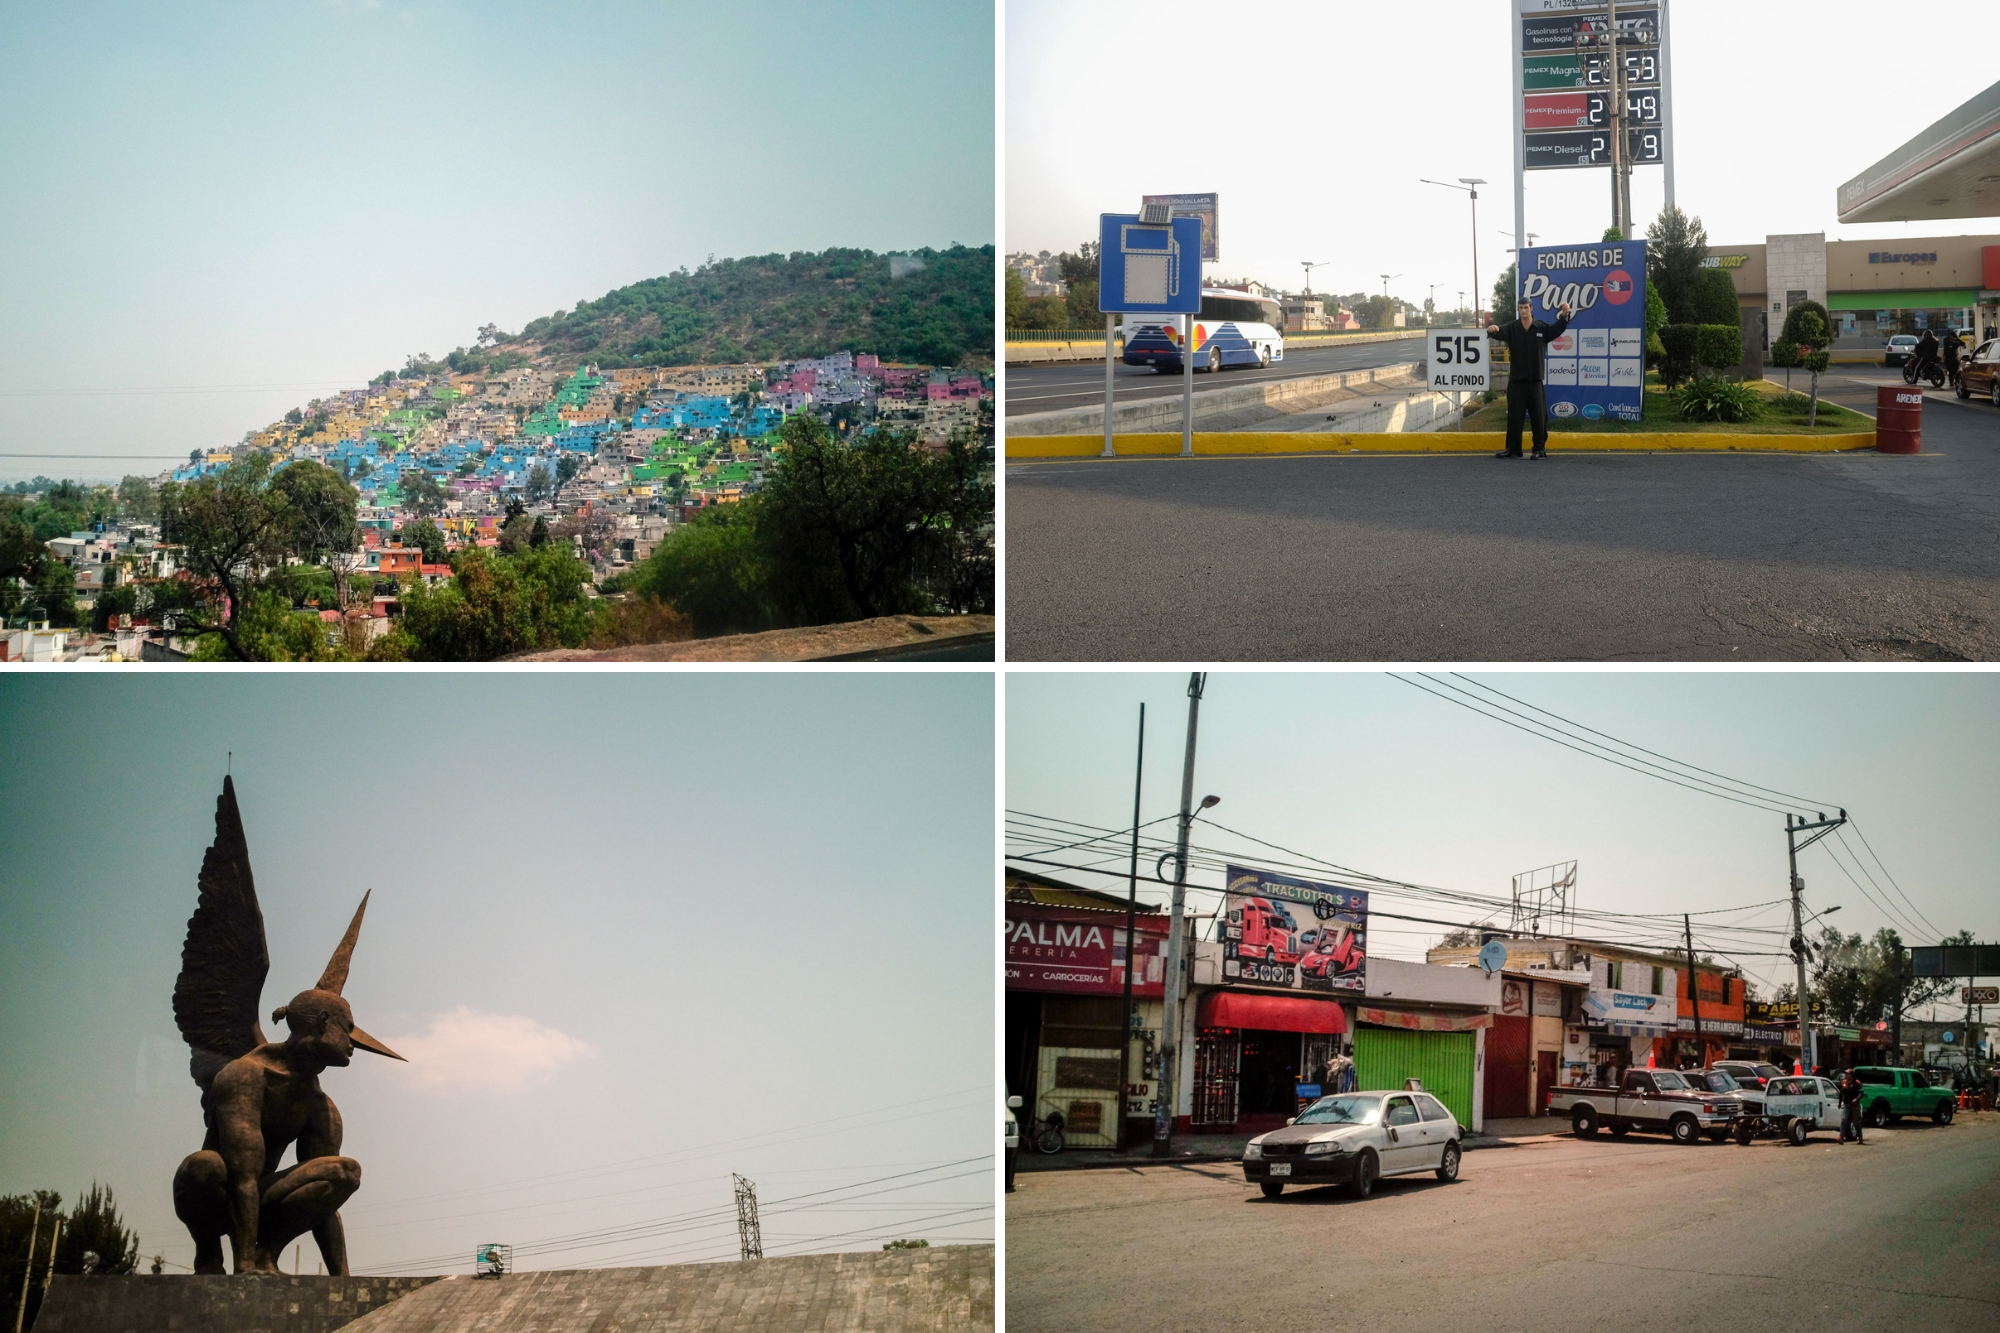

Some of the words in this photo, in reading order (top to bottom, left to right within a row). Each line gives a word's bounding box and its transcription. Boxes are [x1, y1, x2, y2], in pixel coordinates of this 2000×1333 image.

[1525, 27, 1559, 36] Gasolinas
[1532, 35, 1573, 43] tecnología
[1550, 67, 1581, 76] Magna
[1576, 78, 1585, 87] 87
[1547, 107, 1582, 115] Premium
[1577, 118, 1586, 126] 92
[1554, 145, 1584, 154] Diesel
[1537, 250, 1599, 271] FORMAS
[1602, 248, 1624, 267] DE
[1698, 254, 1748, 268] SUBWAY
[1881, 251, 1937, 264] Europea
[1524, 273, 1604, 320] Pago
[1435, 336, 1481, 365] 515
[1581, 364, 1601, 373] ACCOR
[1434, 375, 1449, 386] AL
[1451, 375, 1485, 386] FONDO
[1608, 402, 1640, 412] Confianza
[1618, 412, 1640, 421] TOTAL
[1042, 972, 1104, 983] CARROCERÍAS
[1758, 1003, 1820, 1014] RAMPS
[1700, 1021, 1707, 1031] DE
[1707, 1021, 1743, 1033] HERRAMIENTAS
